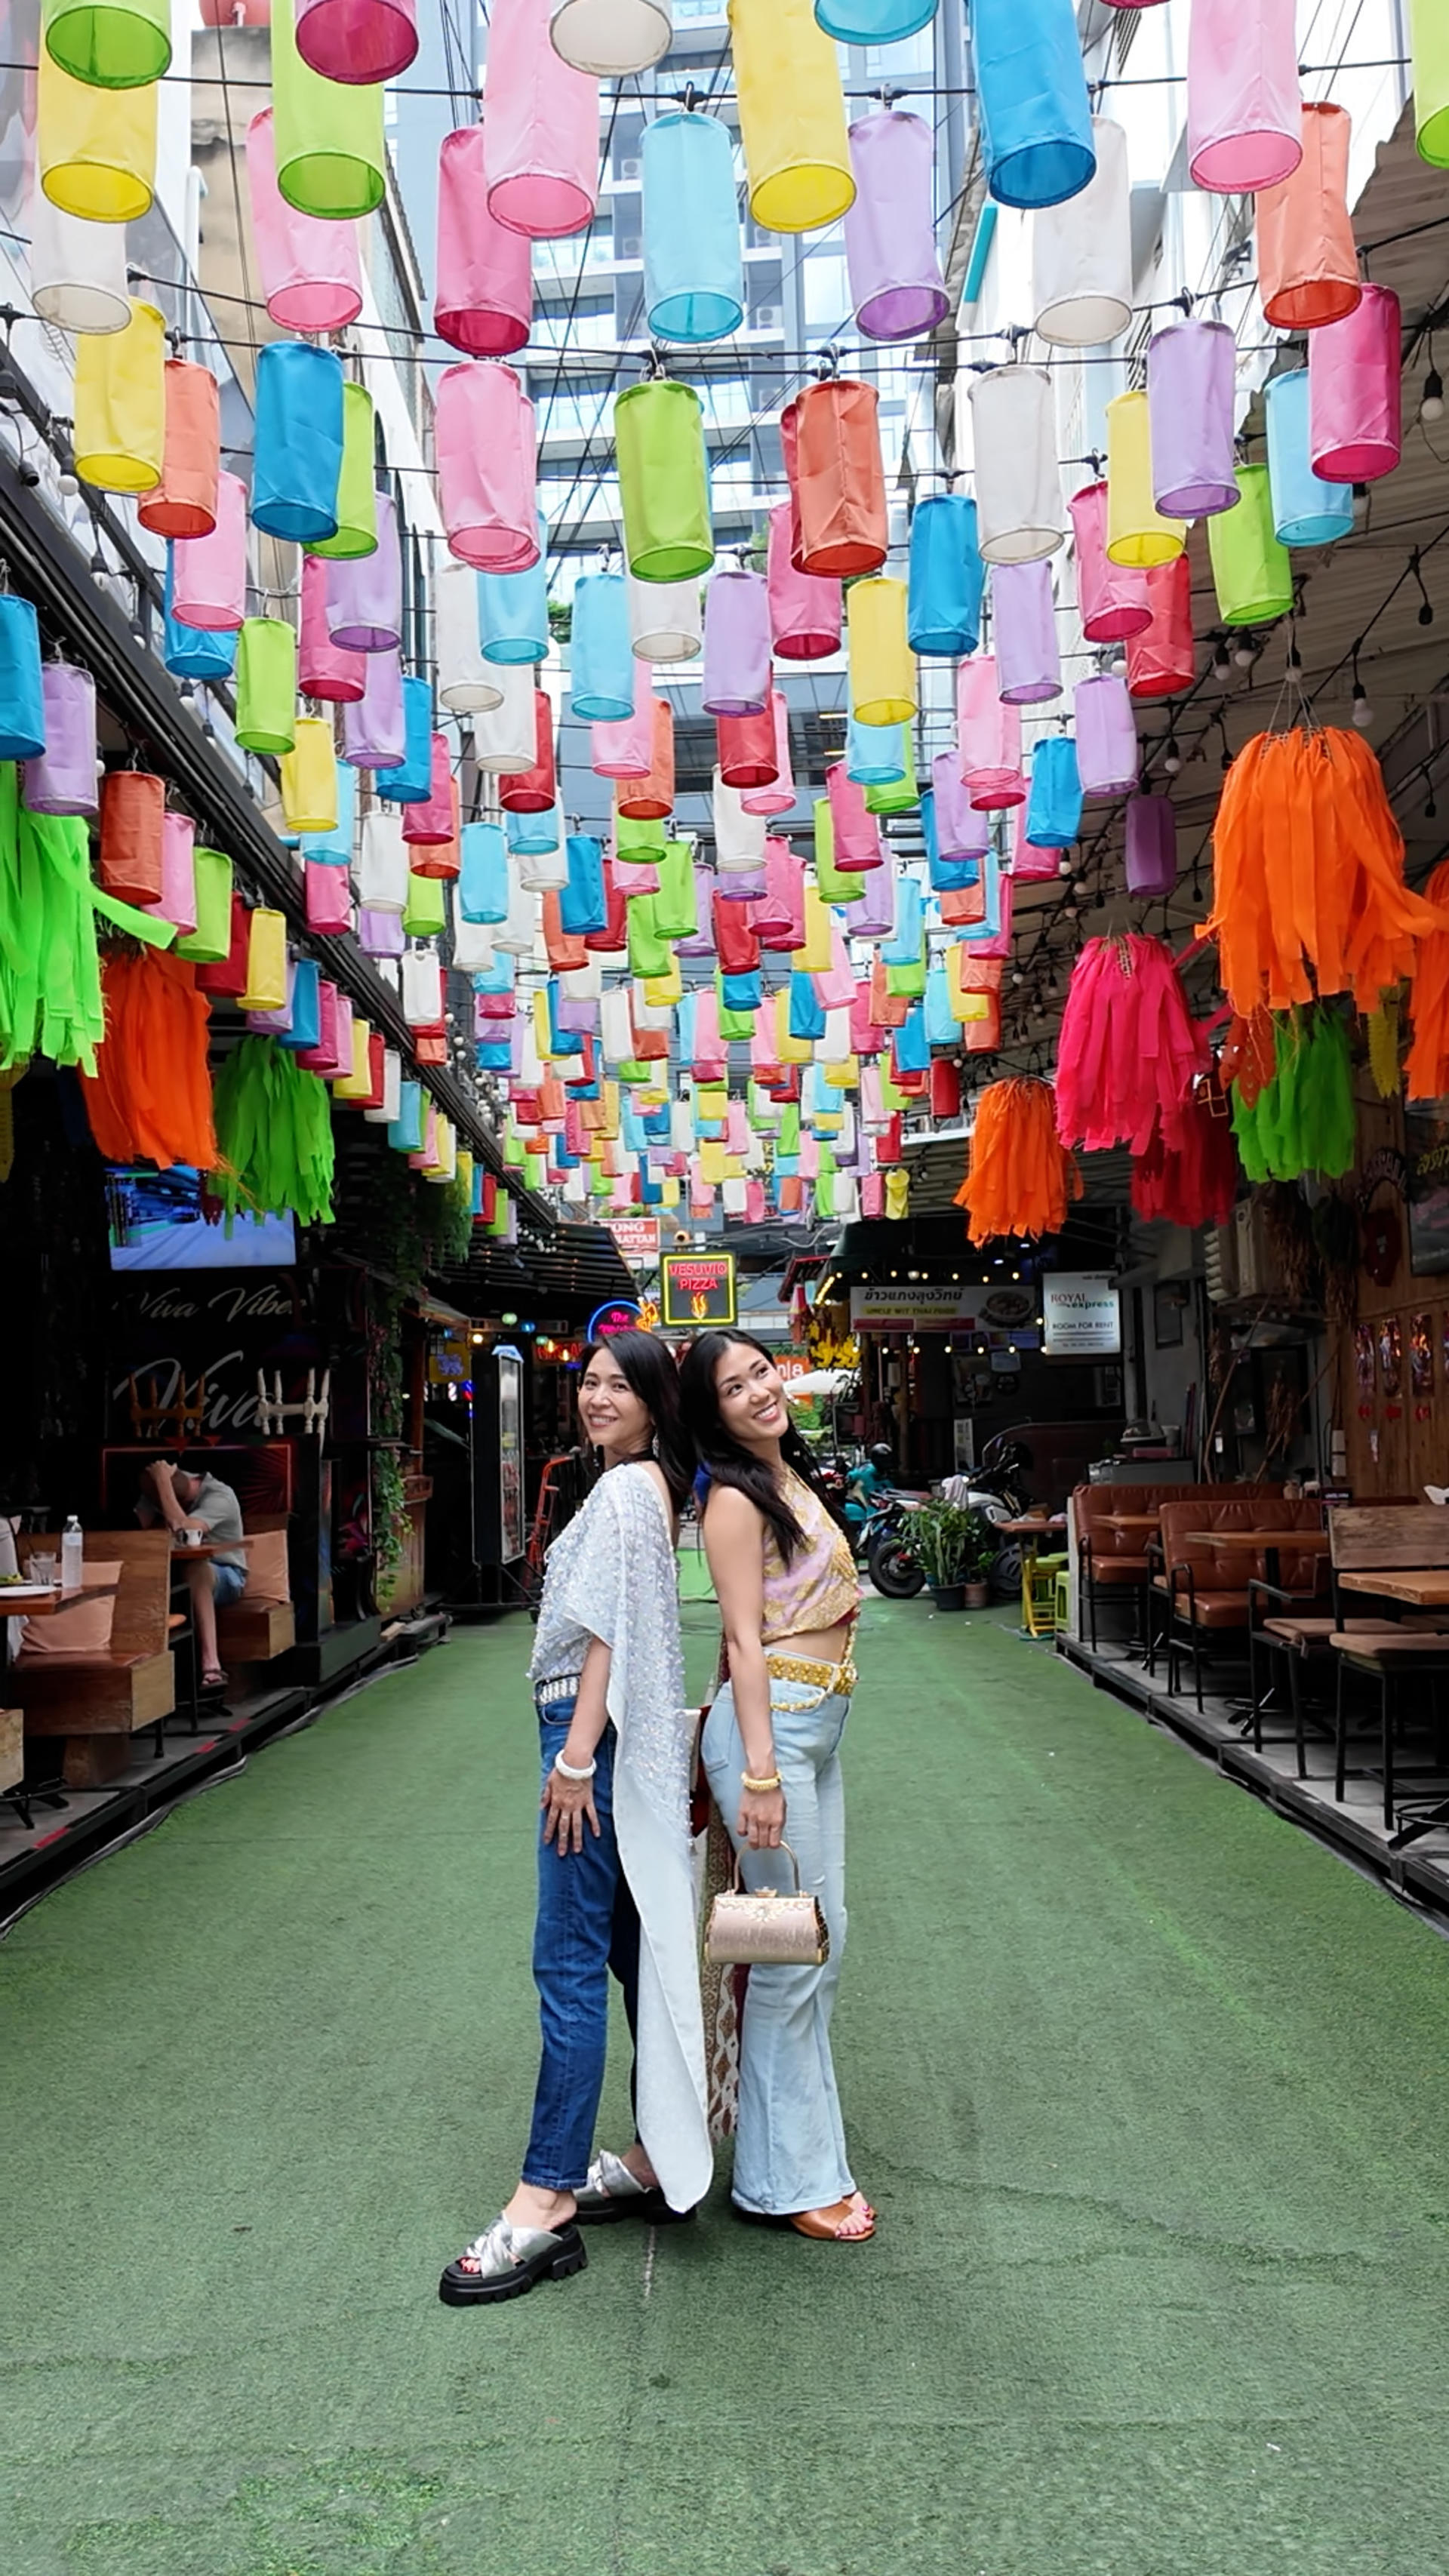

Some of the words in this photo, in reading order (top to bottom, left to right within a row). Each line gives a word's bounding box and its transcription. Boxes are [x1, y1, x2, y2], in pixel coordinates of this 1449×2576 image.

[669, 1262, 727, 1276] VESUVIO
[679, 1278, 718, 1290] PIZZA
[112, 1288, 199, 1319] Viva
[1051, 1293, 1085, 1303] ROYAL
[1072, 1300, 1114, 1310] express
